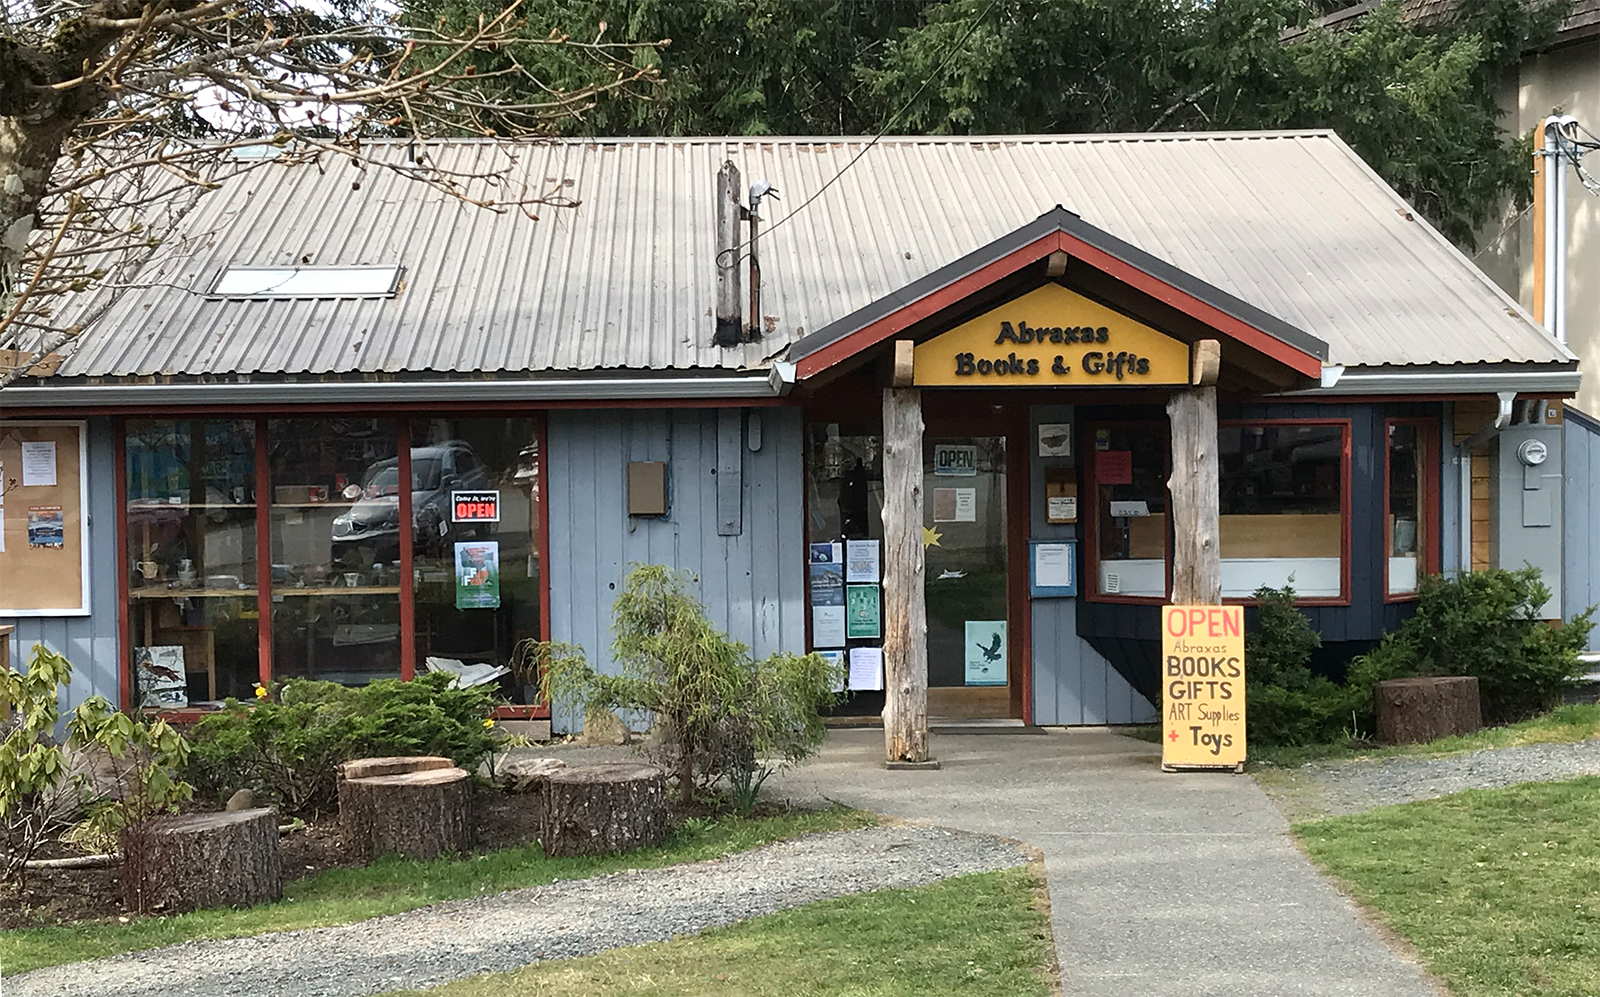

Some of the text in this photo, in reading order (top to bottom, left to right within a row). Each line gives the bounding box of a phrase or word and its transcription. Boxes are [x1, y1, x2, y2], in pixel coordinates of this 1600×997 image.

[995, 321, 1109, 344] Abraxas
[955, 351, 1150, 381] Books & Gifts
[939, 450, 973, 467] OPEN
[457, 503, 495, 518] OPEN
[1167, 608, 1240, 638] OPEN
[1174, 639, 1227, 653] Abraxas
[1167, 656, 1241, 678] BOOKS
[1169, 681, 1232, 700] GIFTS
[1169, 703, 1240, 727] ART Supplies
[1190, 726, 1233, 755] Toys
